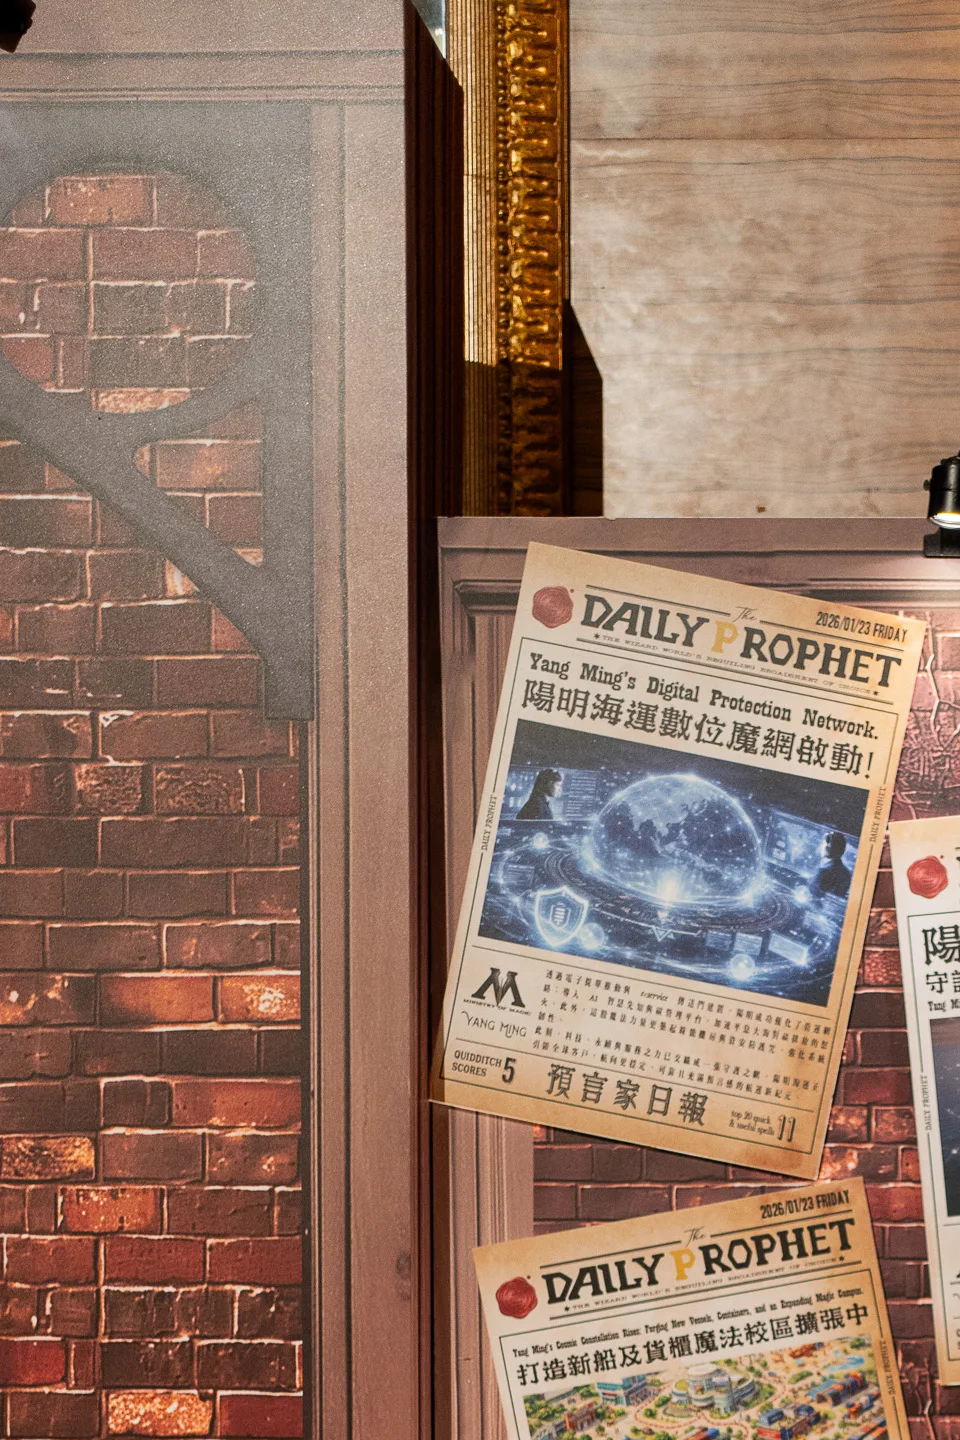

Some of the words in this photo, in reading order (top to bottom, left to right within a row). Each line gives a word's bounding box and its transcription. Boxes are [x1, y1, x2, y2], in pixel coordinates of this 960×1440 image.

[579, 593, 710, 650] DAILY
[709, 619, 902, 689] PROPHET
[815, 610, 872, 636] 2026/01/23
[872, 622, 908, 643] FRIDAY
[527, 651, 571, 681] Yang
[578, 661, 637, 694] Ming's
[644, 675, 701, 707] Digital
[708, 688, 793, 723] Protection
[801, 707, 881, 740] Network.
[459, 1010, 496, 1031] YANG
[497, 1021, 527, 1041] MING
[450, 1060, 487, 1078] SCORES
[452, 1048, 503, 1069] QUIDDITCH
[500, 1056, 517, 1084] 5
[544, 1062, 710, 1127] 預言家日報
[774, 1113, 797, 1143] 11
[759, 1195, 815, 1220] 2026/01/23
[815, 1188, 850, 1208] FRIDAY
[541, 1251, 670, 1305] DAILY
[669, 1217, 859, 1281] PROPHET
[515, 1300, 870, 1388] 打造新船及貨櫃魔法校區擴張中
